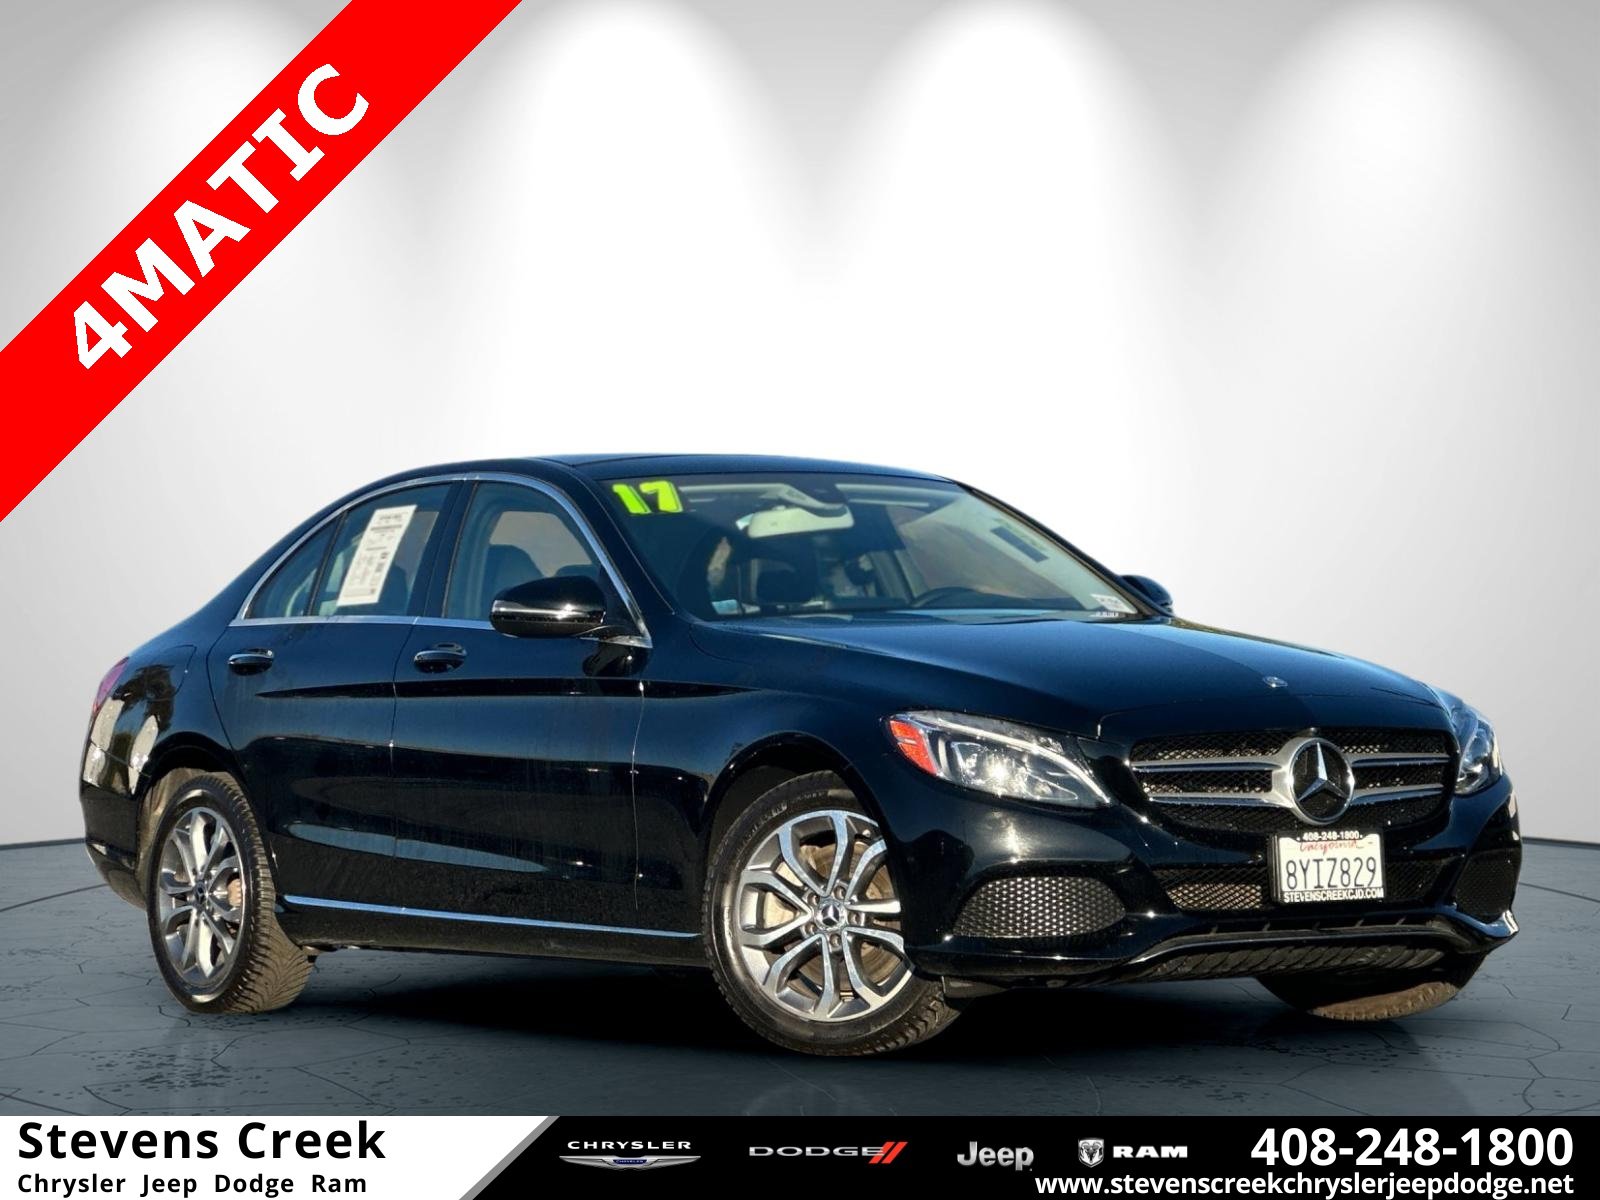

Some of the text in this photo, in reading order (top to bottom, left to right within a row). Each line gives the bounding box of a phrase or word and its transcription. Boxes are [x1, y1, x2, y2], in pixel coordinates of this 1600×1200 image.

[612, 480, 684, 514] 17
[1285, 856, 1377, 890] 8YIZ829
[1283, 887, 1385, 903] STEVENSCREEKCJD.COM
